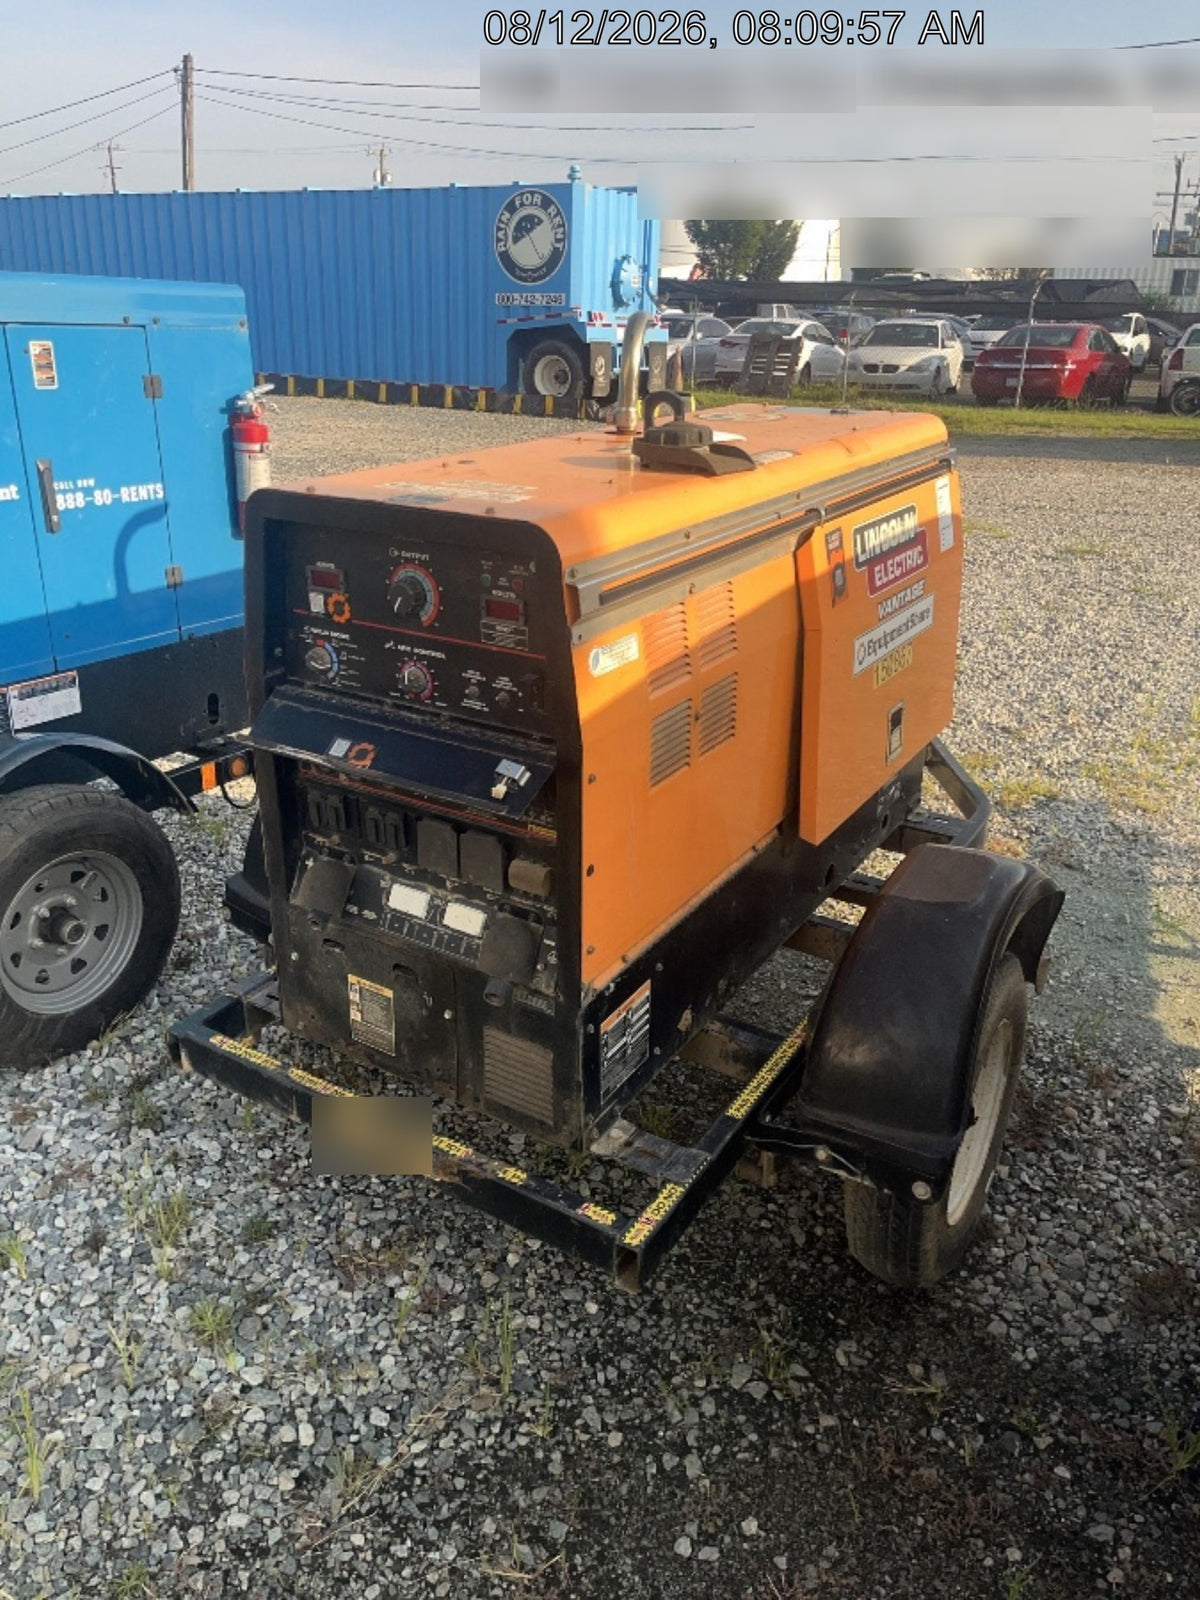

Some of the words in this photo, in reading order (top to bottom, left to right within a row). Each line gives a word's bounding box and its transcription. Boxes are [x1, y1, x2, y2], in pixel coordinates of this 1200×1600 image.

[497, 210, 512, 252] RAIN
[514, 193, 542, 208] FOR
[546, 204, 564, 251] RENT
[855, 511, 915, 562] LINCOLN
[874, 544, 924, 588] ELECTRIC
[877, 579, 926, 621] VANTAGE
[867, 607, 930, 657] EquipmentShare
